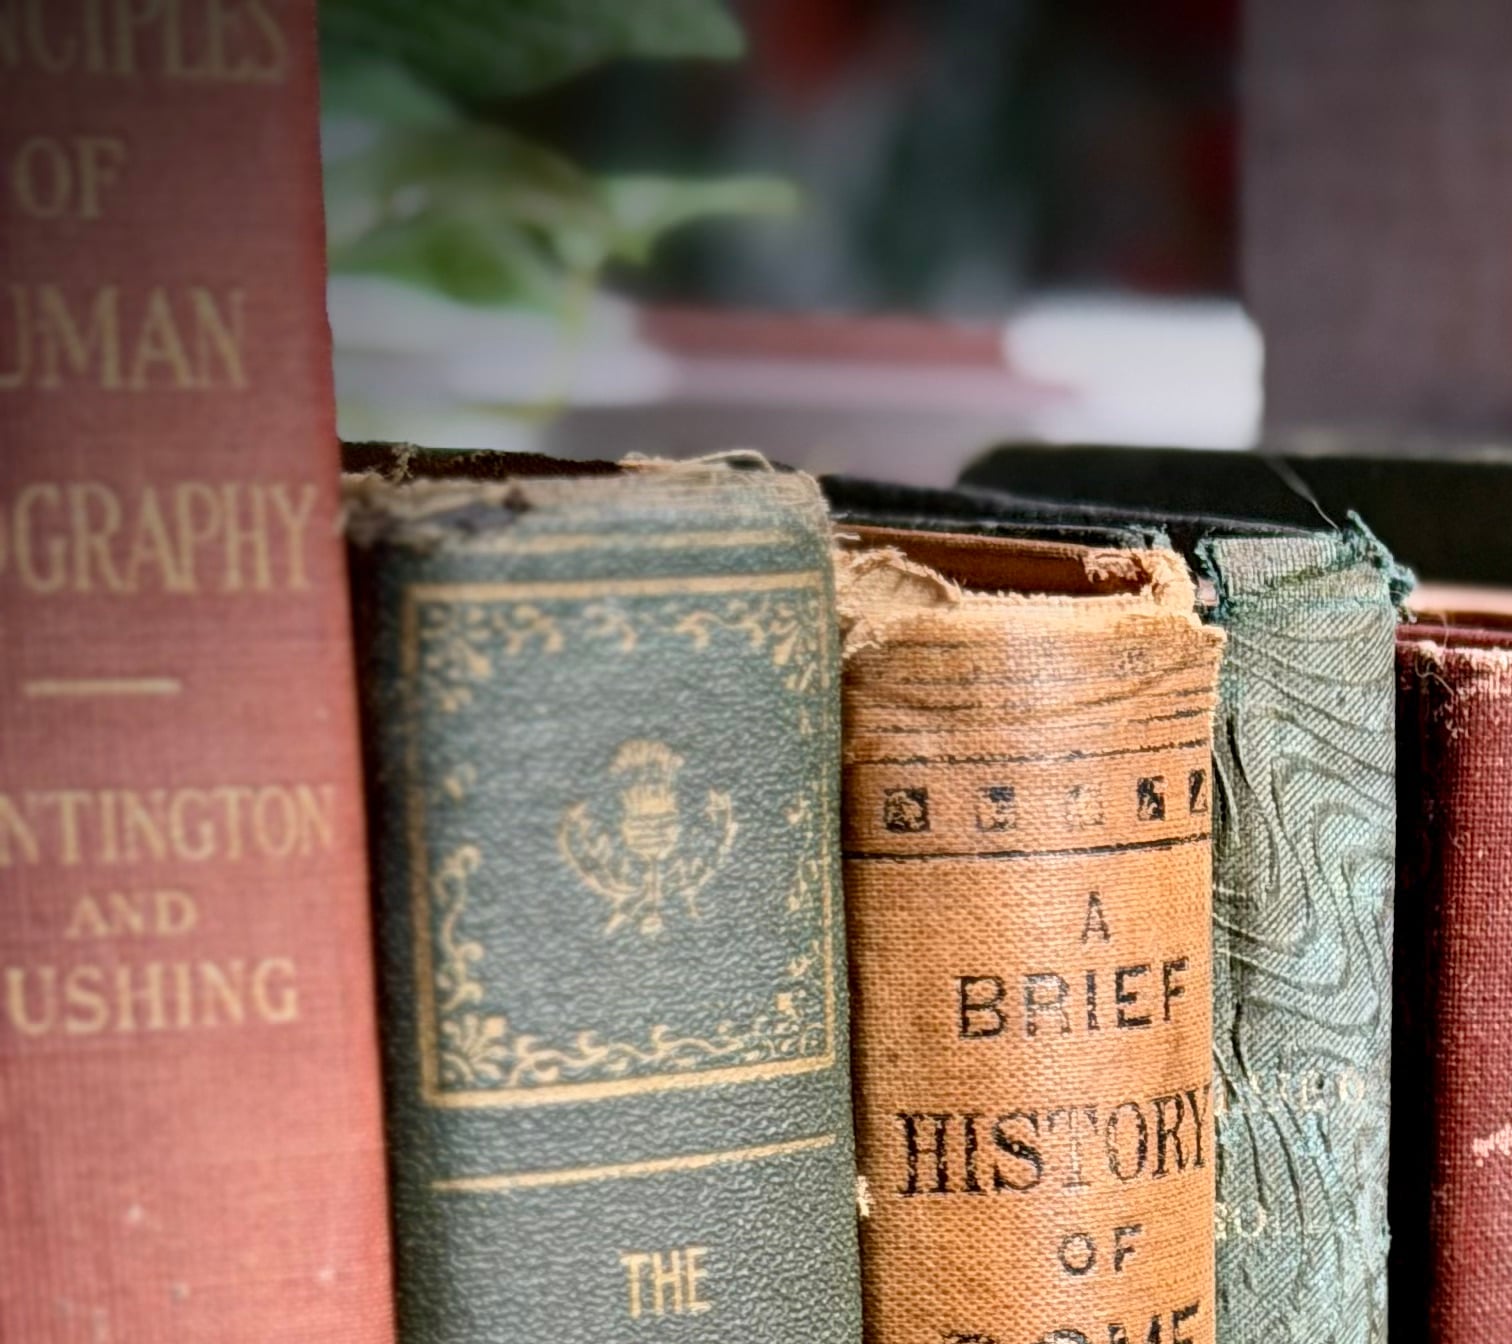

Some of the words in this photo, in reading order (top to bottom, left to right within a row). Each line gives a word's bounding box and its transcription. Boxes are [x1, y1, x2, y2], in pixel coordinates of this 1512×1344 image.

[13, 136, 127, 220] OF
[0, 481, 318, 594] GRAPHY
[0, 783, 336, 866] NTINGTON
[65, 888, 198, 939] AND
[1080, 890, 1112, 945] A
[6, 956, 299, 1035] USHING
[955, 955, 1191, 1040] BRIEF
[895, 1084, 1214, 1197] HISTORY
[619, 1245, 713, 1319] THE
[1058, 1223, 1145, 1277] OF
